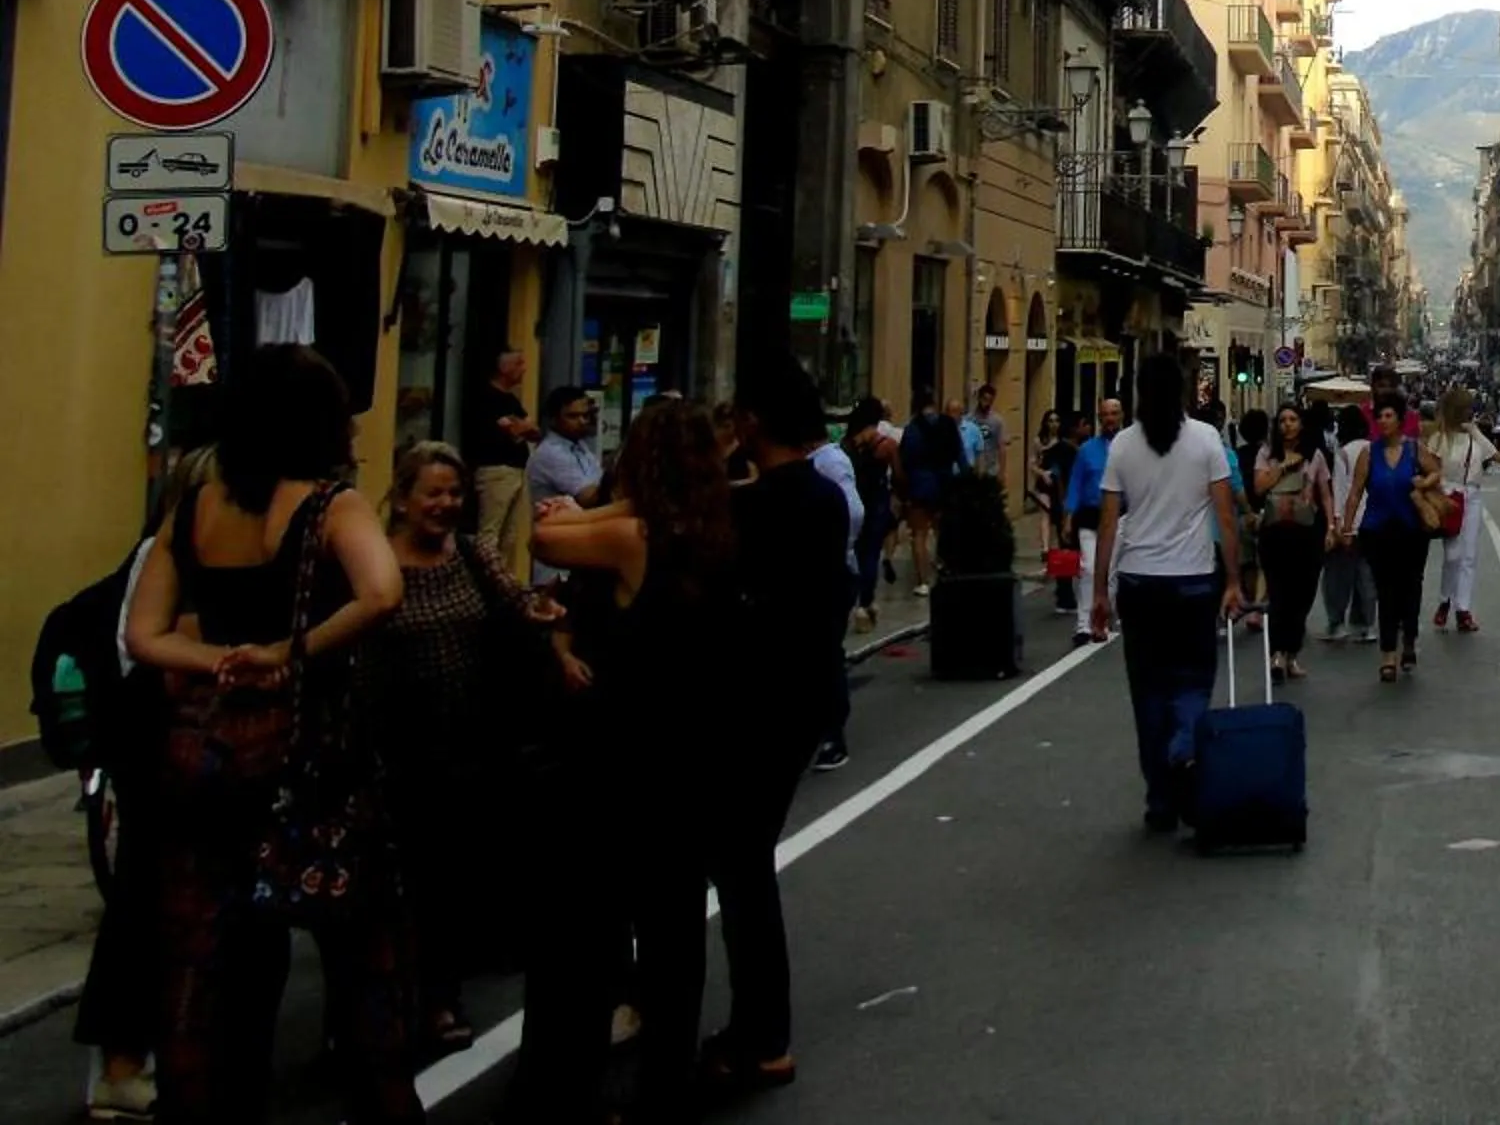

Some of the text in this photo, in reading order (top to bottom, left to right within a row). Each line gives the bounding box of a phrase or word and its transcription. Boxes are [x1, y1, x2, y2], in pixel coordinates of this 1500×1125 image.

[423, 117, 511, 173] La Caramella
[118, 213, 139, 236] 0
[172, 211, 212, 235] 24
